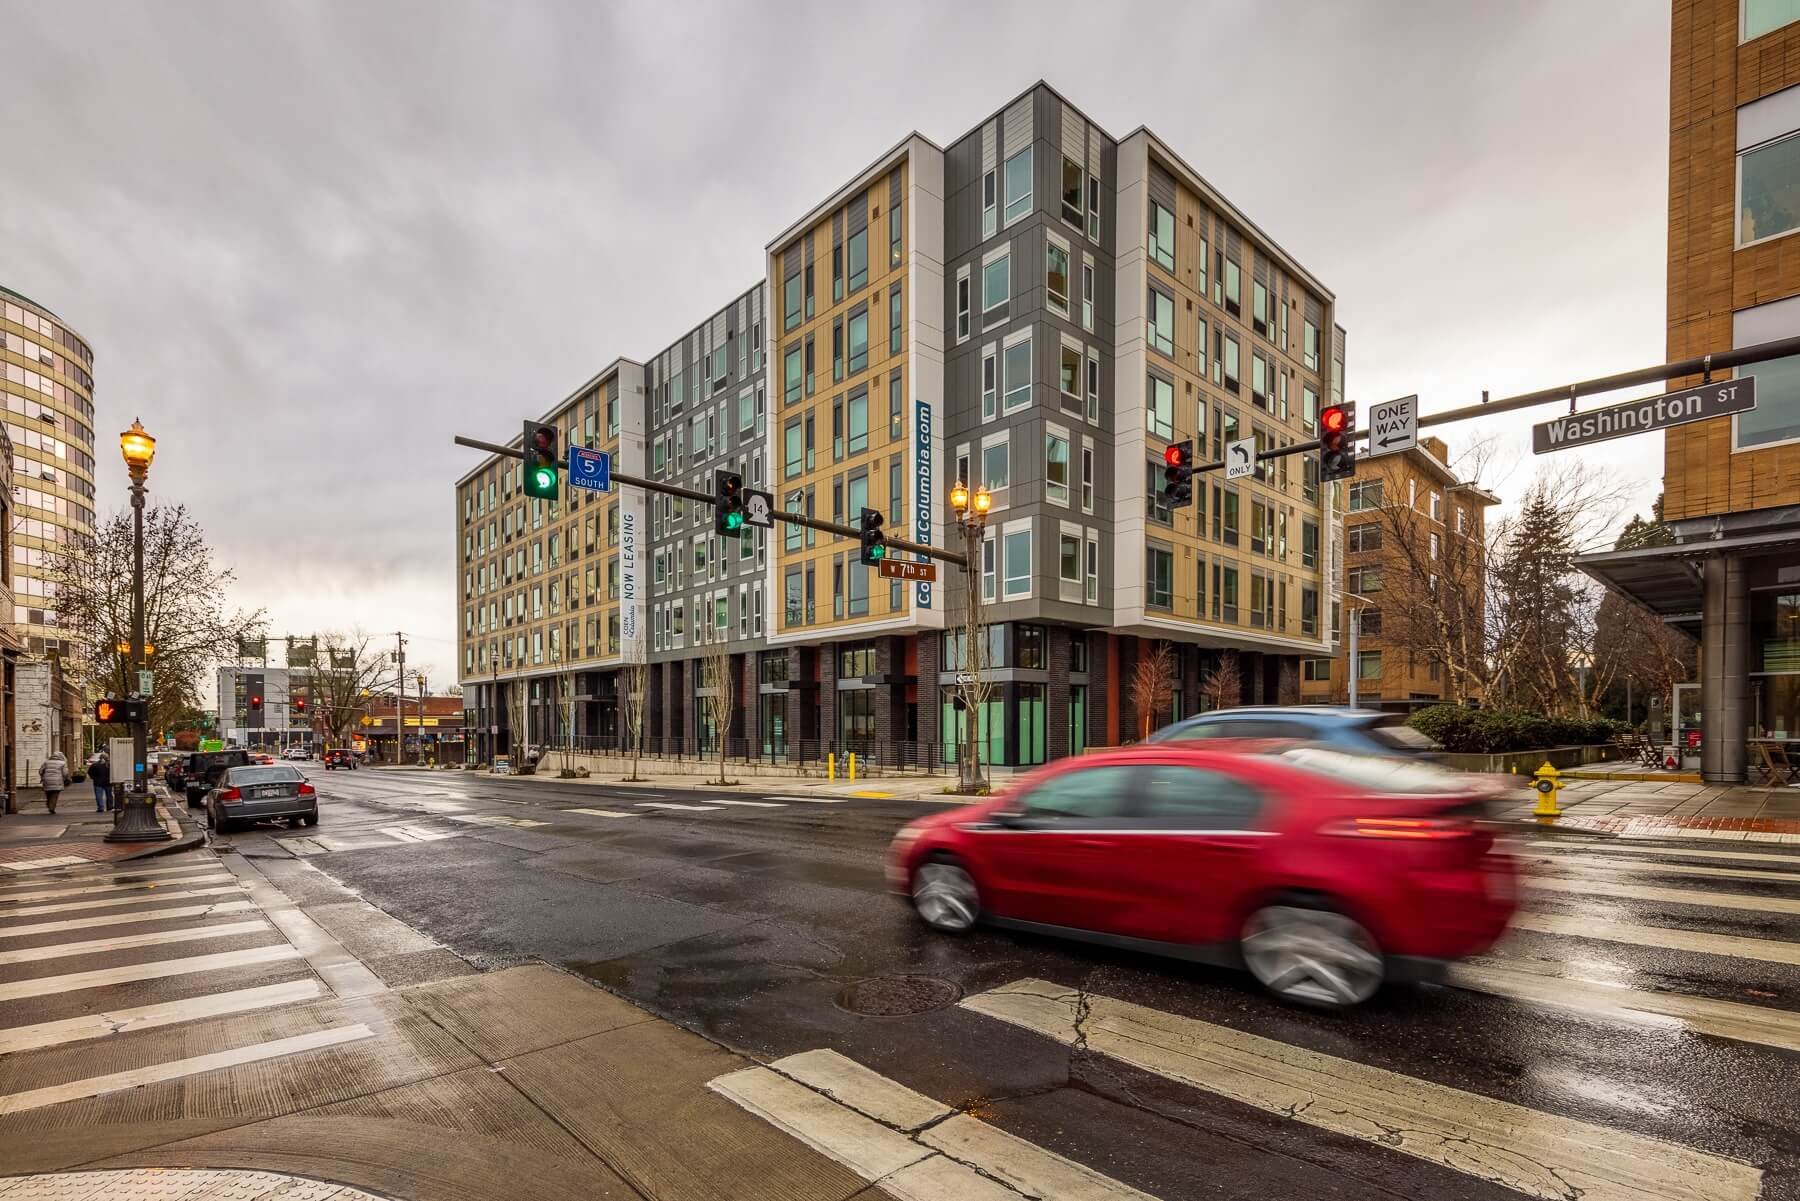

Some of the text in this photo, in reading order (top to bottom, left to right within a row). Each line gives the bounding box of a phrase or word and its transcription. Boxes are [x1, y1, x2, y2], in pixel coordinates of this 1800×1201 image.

[1377, 402, 1409, 420] ONE
[1547, 386, 1738, 444] Washington ST
[1376, 417, 1410, 436] WAY
[584, 460, 595, 473] 5
[1229, 464, 1252, 477] ONLY
[575, 477, 604, 489] SOUTH
[754, 503, 763, 514] 14
[623, 514, 634, 600] NOW LEASING
[900, 563, 915, 577] 7th
[920, 568, 927, 576] ST
